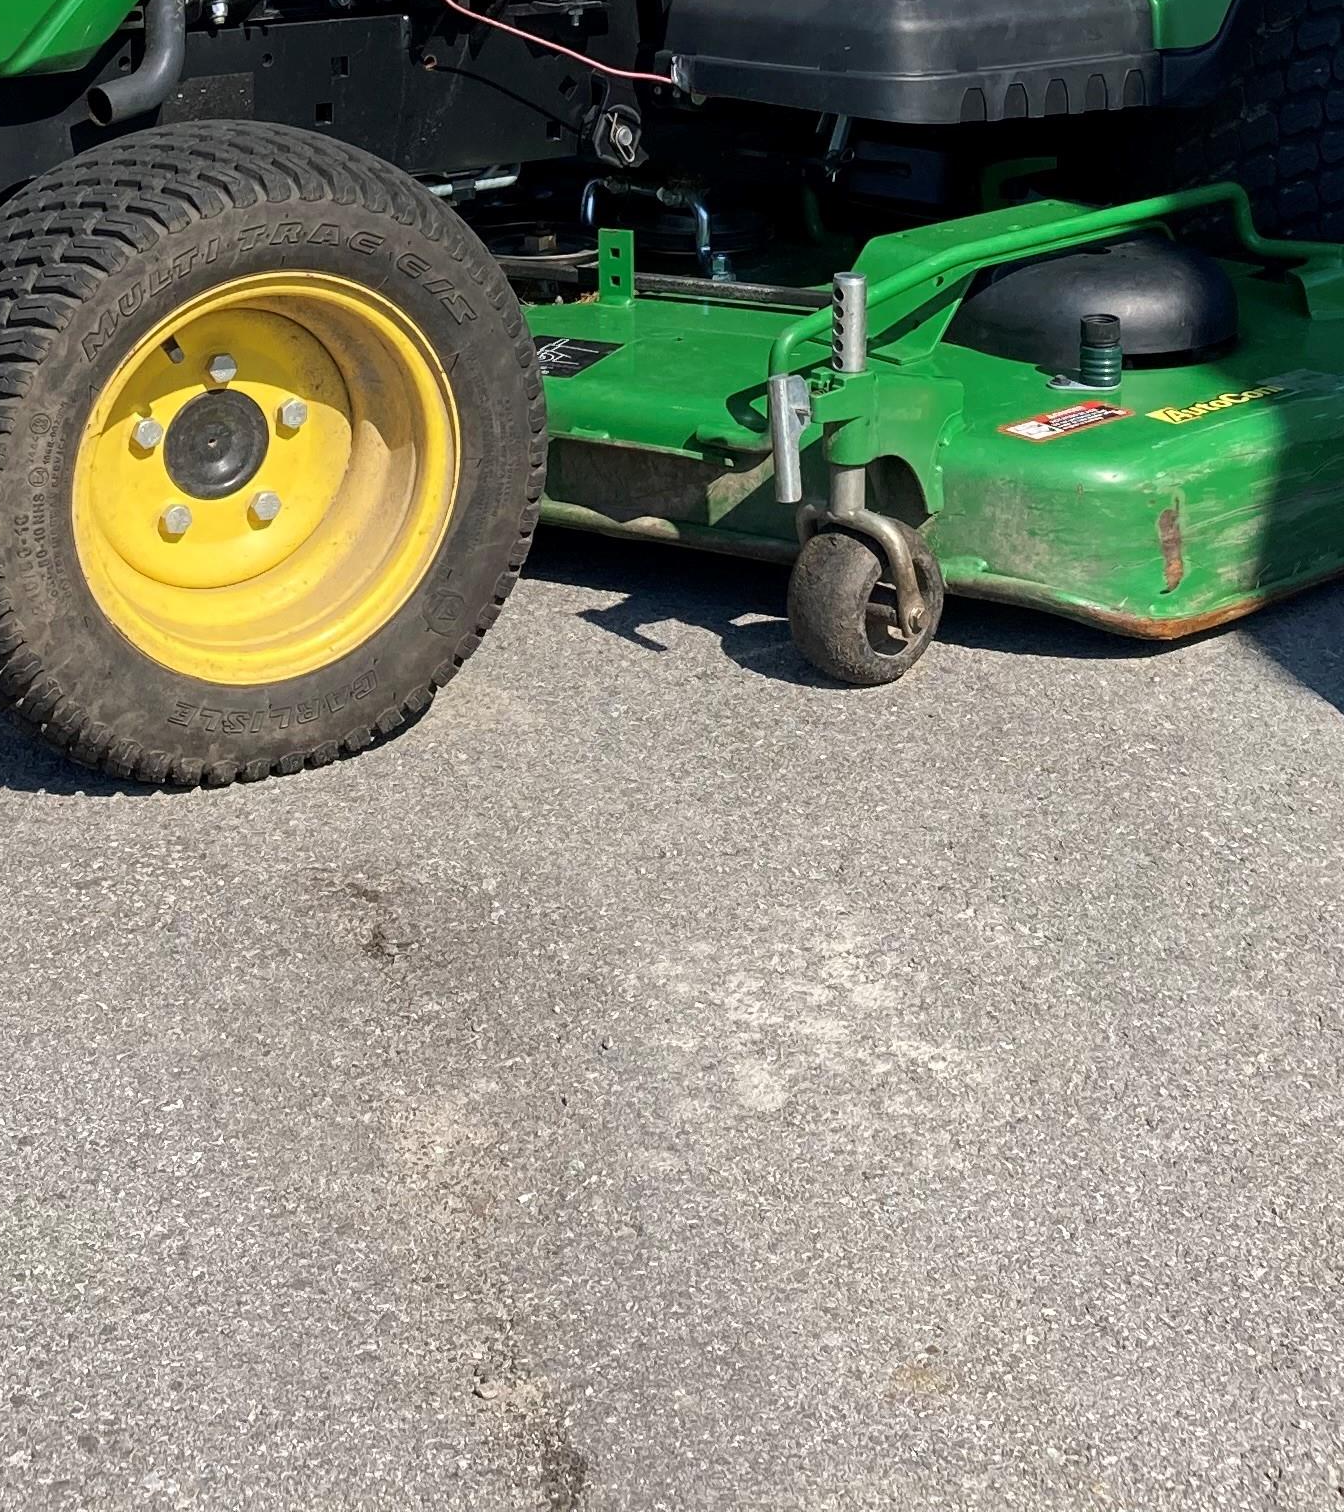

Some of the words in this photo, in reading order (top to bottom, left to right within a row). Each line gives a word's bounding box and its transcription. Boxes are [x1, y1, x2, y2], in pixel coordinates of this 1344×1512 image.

[81, 238, 220, 361] MULTI
[237, 221, 386, 254] TRAC
[167, 668, 379, 734] CARLISLE
